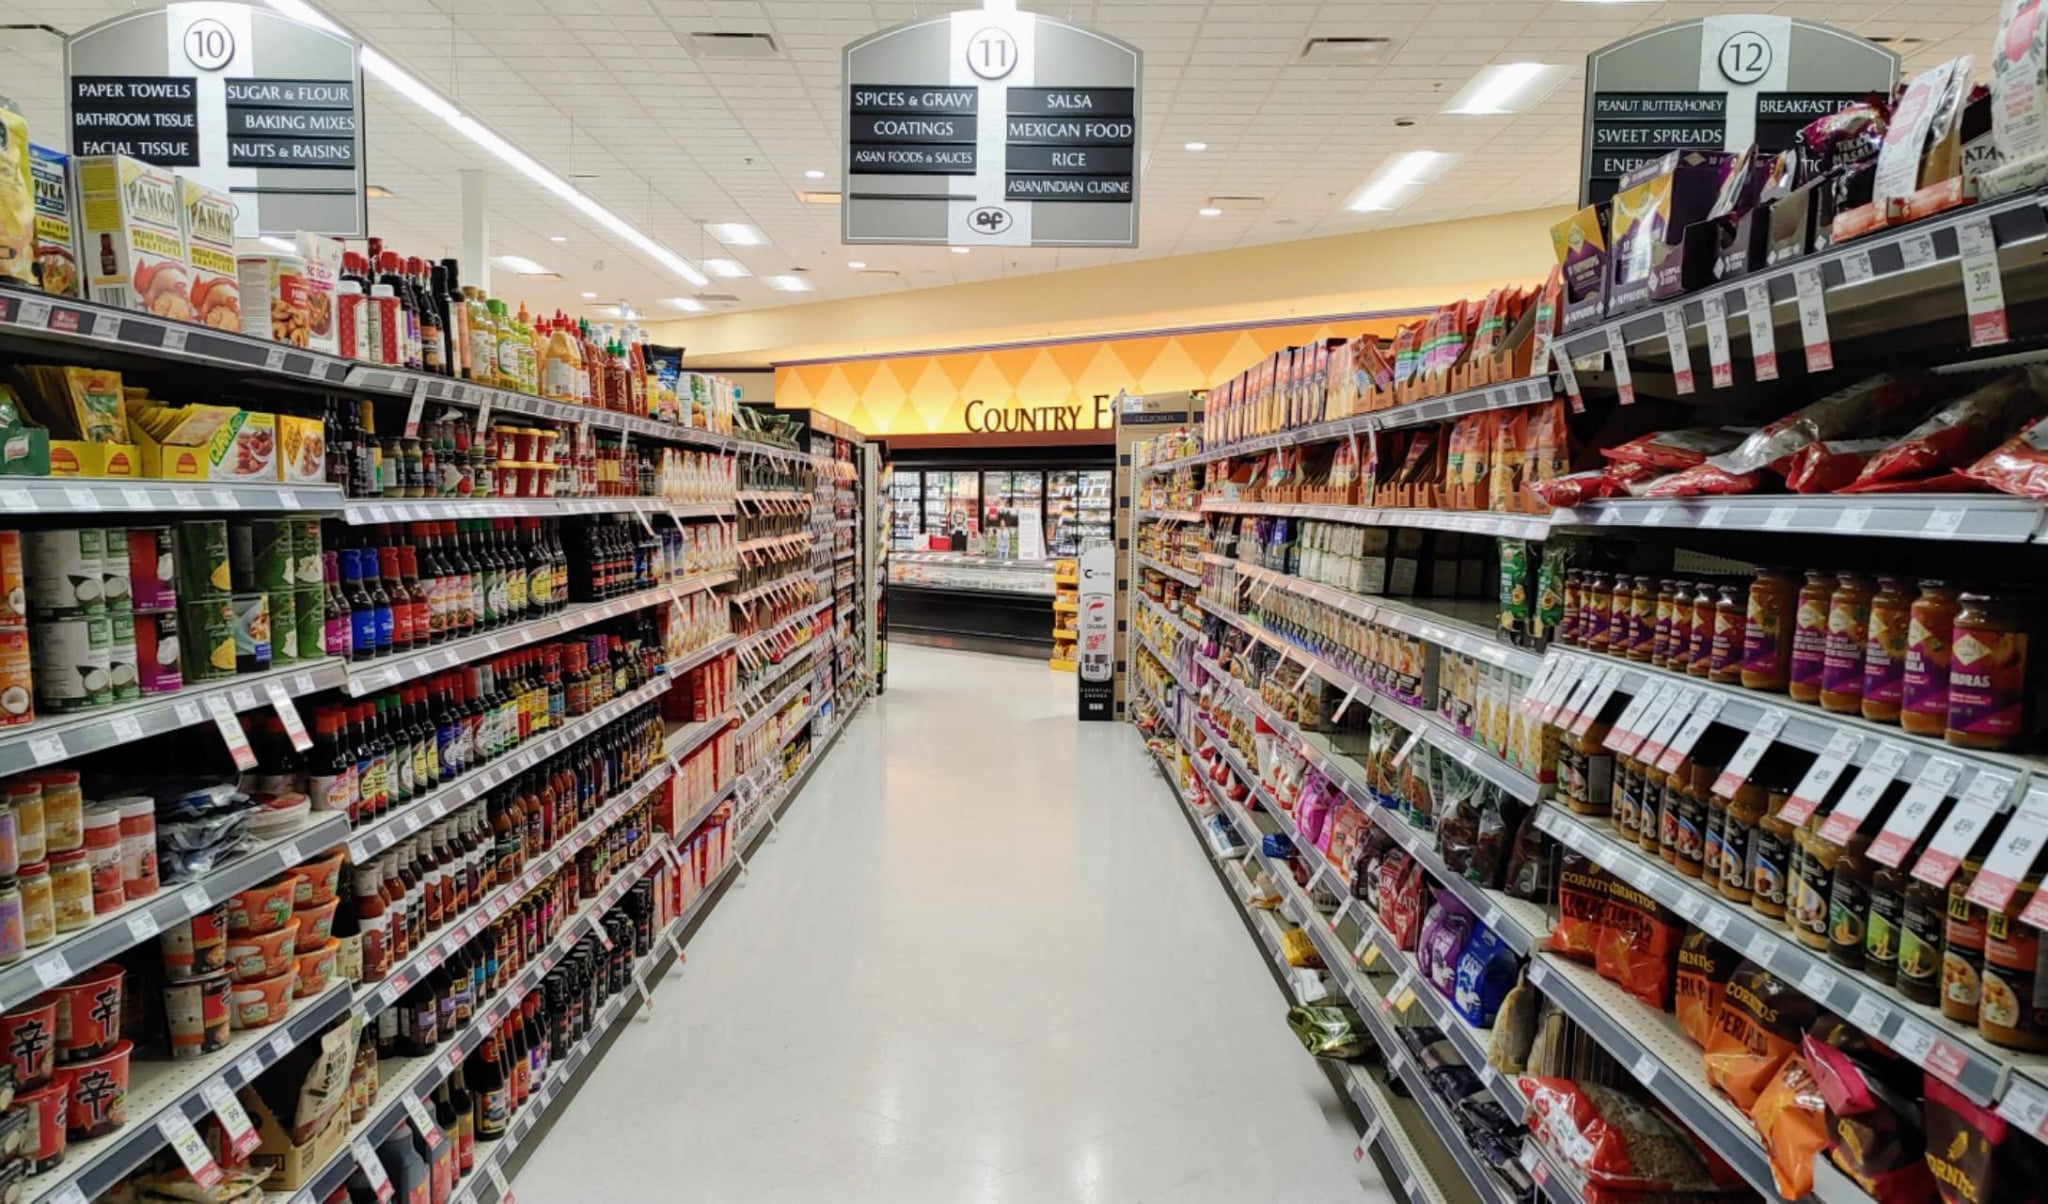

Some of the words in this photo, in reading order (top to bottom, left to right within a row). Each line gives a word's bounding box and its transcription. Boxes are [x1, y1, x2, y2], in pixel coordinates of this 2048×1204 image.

[192, 29, 226, 59] 10
[978, 38, 1007, 68] 11
[1730, 42, 1763, 73] 12
[78, 83, 125, 98] PAPER
[129, 84, 191, 98] TOWELS
[227, 84, 280, 101] SUGAR
[283, 88, 295, 101] &
[298, 86, 350, 102] FLOUR
[854, 91, 905, 107] SPICES
[908, 93, 919, 107] &
[921, 92, 974, 108] GRAVY
[1046, 93, 1093, 109] SALSA
[1596, 99, 1639, 113] PEANUT
[1641, 100, 1723, 113] BUTTER/HONEY
[1759, 100, 1834, 113] BREAKFAST
[75, 112, 151, 128] BATHROOM
[154, 113, 195, 128] TISSUE
[244, 114, 306, 130] BAKING
[308, 116, 355, 131] MIXES
[873, 120, 954, 137] COATINGS
[1008, 122, 1081, 138] MEXICAN
[1084, 123, 1132, 139] FOOD
[1597, 127, 1649, 144] SWEET
[1652, 128, 1723, 144] SPREADS
[82, 141, 135, 156] FACIAL
[138, 141, 190, 157] TISSUE
[232, 143, 276, 158] NUTS
[278, 146, 289, 158] &
[292, 143, 350, 160] RAISINS
[854, 150, 886, 163] ASIAN
[888, 150, 924, 164] FOODS
[925, 153, 933, 164] &
[935, 151, 973, 165] SAUCES
[1051, 152, 1087, 168] RICE
[1007, 180, 1084, 194] ASIAN/INDIAN
[1087, 180, 1131, 195] CUISINE
[129, 180, 176, 218] PANKO
[190, 201, 231, 236] PANKO
[965, 399, 1082, 433] COUNTRY
